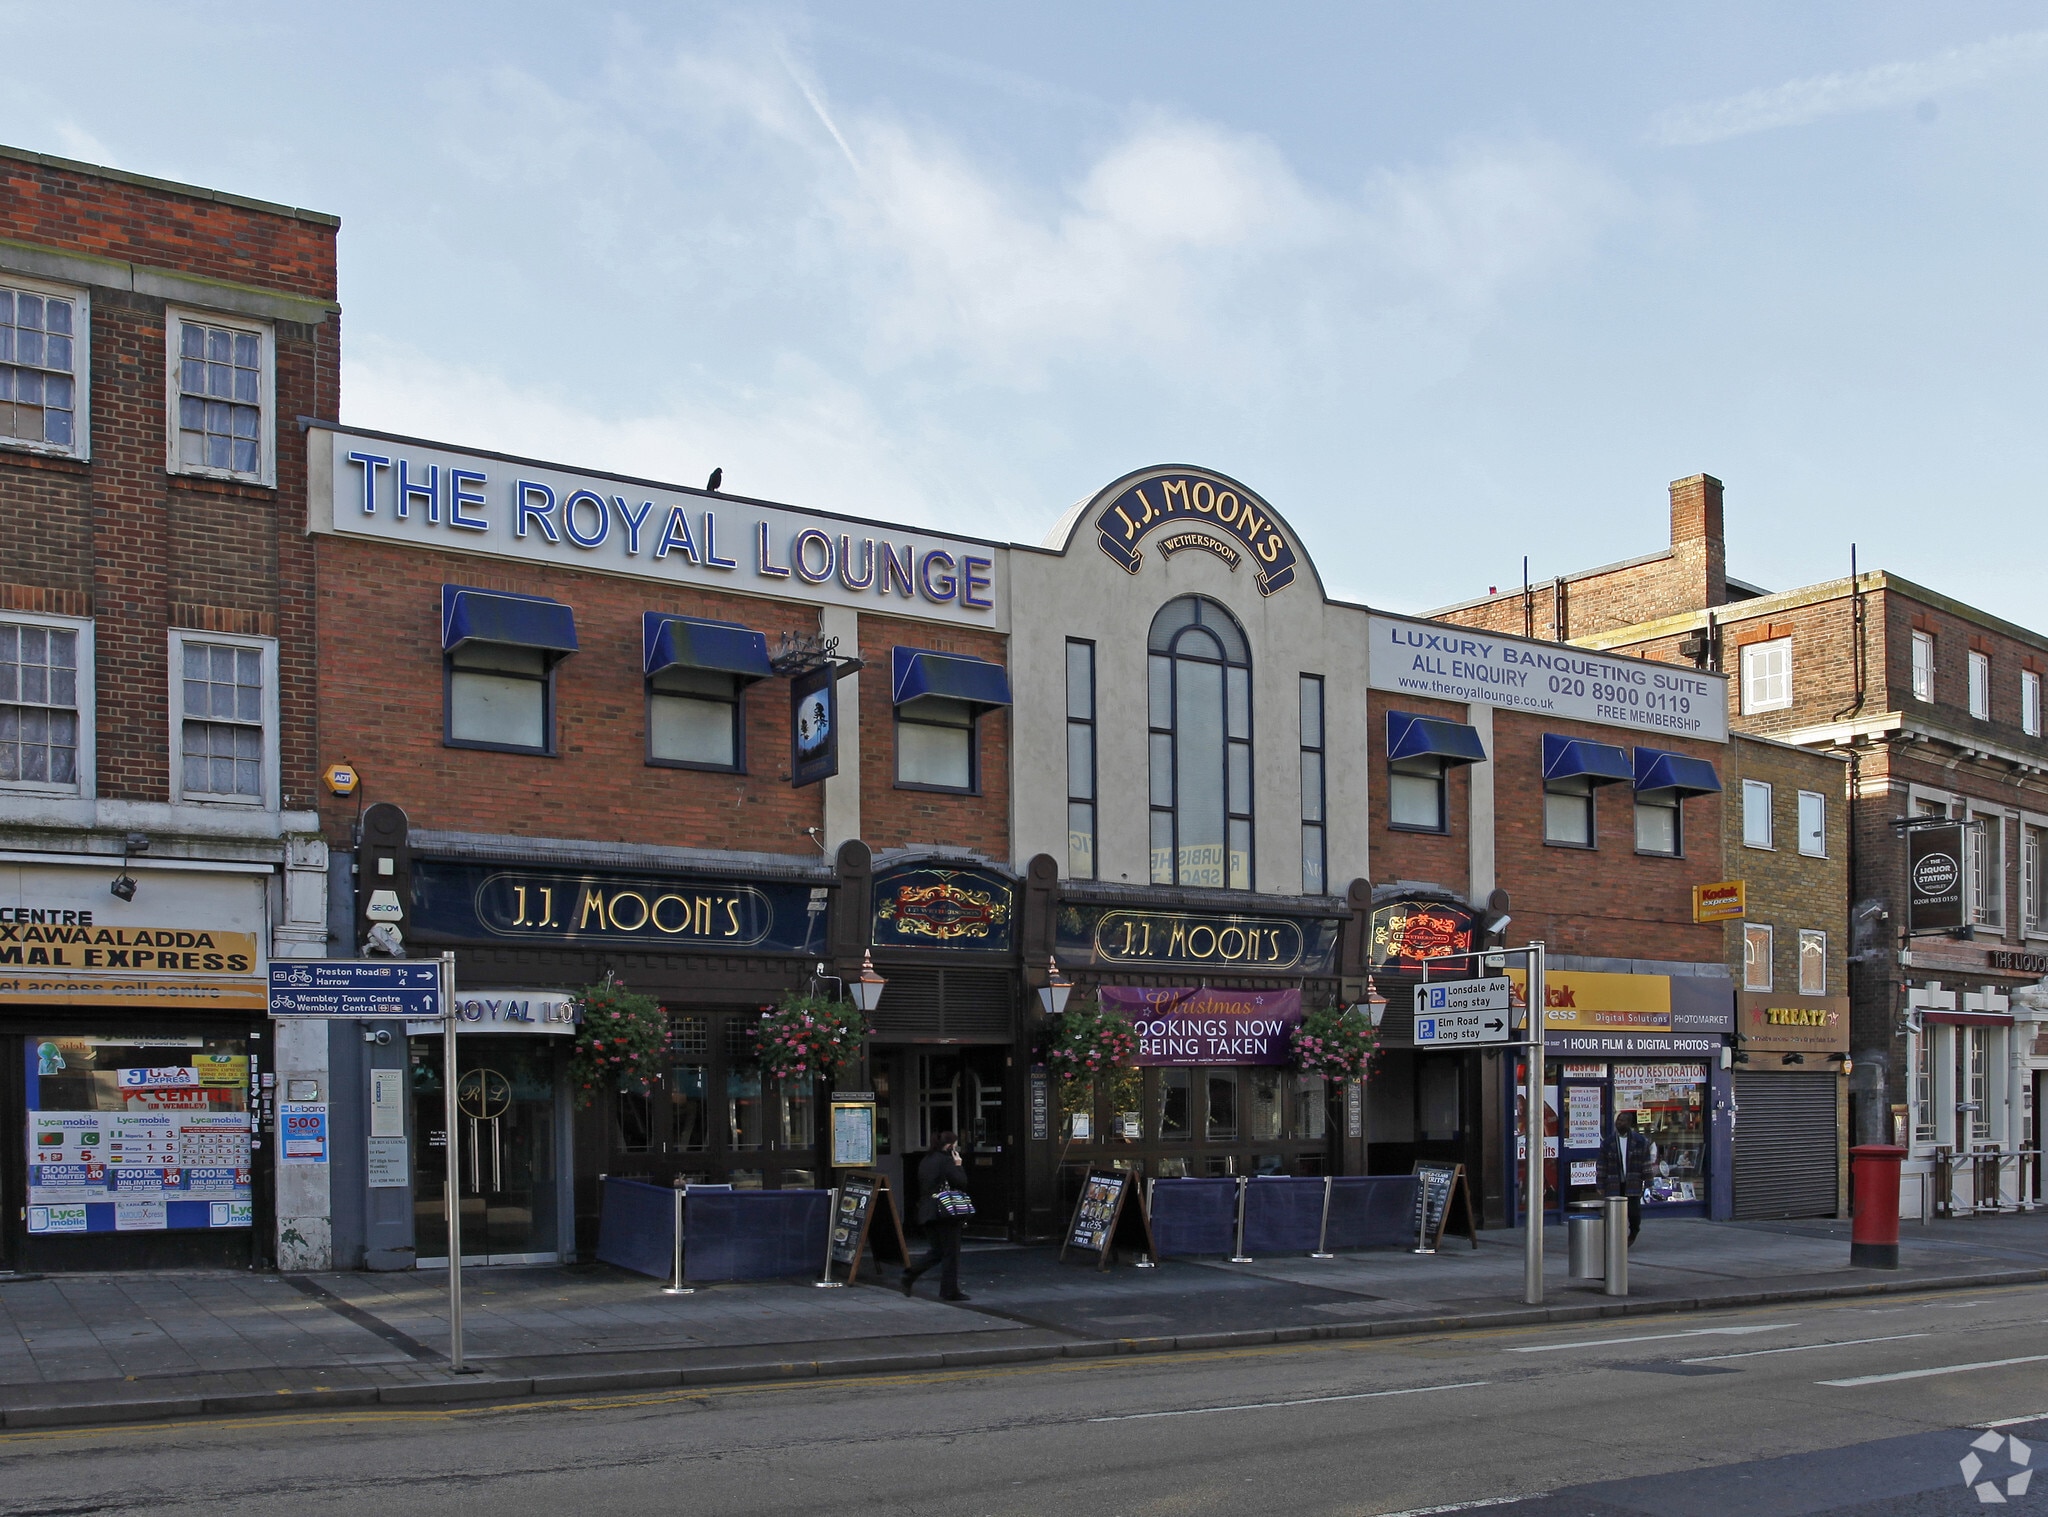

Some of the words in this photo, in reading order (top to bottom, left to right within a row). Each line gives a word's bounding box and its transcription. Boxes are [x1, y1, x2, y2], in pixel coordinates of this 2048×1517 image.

[1114, 489, 1160, 541] J.J.
[1161, 479, 1284, 562] MOON'S
[348, 450, 490, 532] THE
[515, 479, 738, 570] ROYAL
[756, 520, 994, 611] LOUNGE
[1164, 534, 1236, 562] WETHERSPOON
[1391, 628, 1493, 659] LUXURY
[1503, 648, 1646, 686] BANQUETING
[1653, 674, 1708, 697] SUITE
[1412, 654, 1447, 676] ALL
[1452, 660, 1528, 688] ENQUIRY
[1548, 675, 1585, 697] 020
[1592, 682, 1639, 706] 8900
[1646, 691, 1690, 714] 0119
[1398, 677, 1554, 709] www.theroyallounge.co.uk
[1597, 704, 1626, 721] FREE
[1630, 709, 1701, 732] MEMBERSHIP
[334, 773, 350, 782] ADT
[1920, 865, 1951, 875] LIQUOR
[1919, 873, 1953, 883] STATION
[1702, 886, 1738, 901] Kodak
[1702, 897, 1739, 906] express
[372, 904, 399, 912] SECOM
[513, 886, 559, 929] J.J.
[580, 887, 740, 936] MOON'S
[1, 907, 93, 926] CENTRE
[1121, 921, 1154, 956] J.J.
[1167, 921, 1280, 962] MOON'S
[84, 949, 248, 972] EXPRESS
[1994, 951, 2012, 969] THE
[316, 968, 352, 976] Preston
[356, 968, 379, 976] Road
[317, 978, 350, 986] Harrow
[399, 978, 406, 986] 4
[112, 983, 148, 997] call
[1448, 985, 1486, 995] Lonsdale
[1489, 982, 1505, 991] Ave
[297, 995, 339, 1004] Wembley
[342, 995, 366, 1003] Town
[369, 995, 401, 1003] Centre
[1145, 990, 1257, 1016] Christmas
[1448, 999, 1468, 1009] Long
[1471, 997, 1490, 1007] stay
[297, 1004, 339, 1013] Wembley
[342, 1004, 377, 1012] Central
[1438, 1018, 1454, 1027] Elm
[1457, 1016, 1479, 1026] Road
[1595, 1013, 1625, 1024] Digital
[1628, 1013, 1667, 1023] Solutions
[1674, 1014, 1729, 1024] PHOTOMARKET
[1767, 1008, 1827, 1027] TREATZ
[1133, 1020, 1227, 1037] OOKINGS
[1235, 1020, 1283, 1037] NOW
[1438, 1030, 1458, 1040] Long
[1461, 1030, 1480, 1039] stay
[1139, 1039, 1199, 1056] BEING
[1207, 1038, 1268, 1055] TAKEN
[1562, 1039, 1568, 1049] 1
[1571, 1039, 1598, 1049] HOUR
[1602, 1039, 1623, 1050] FILM
[1627, 1039, 1634, 1050] &
[1637, 1039, 1671, 1050] DIGITAL
[1673, 1039, 1709, 1050] PHOTOS
[1614, 1067, 1644, 1078] PHOTO
[1647, 1065, 1706, 1077] RESTORATION
[122, 1089, 147, 1102] PC
[154, 1088, 232, 1102] CENTRE
[461, 1086, 480, 1101] R
[162, 1102, 207, 1110] WEMBLEY)
[290, 1104, 326, 1113] Lebara
[38, 1119, 98, 1128] Lycamobile
[117, 1116, 170, 1125] Lycamobile
[190, 1116, 242, 1125] Lycamobile
[288, 1117, 320, 1128] 500
[166, 1130, 174, 1138] 3
[147, 1143, 153, 1151] 1
[166, 1143, 174, 1151] 5
[80, 1150, 92, 1161] 5
[147, 1155, 154, 1163] 7
[161, 1155, 174, 1163] 12
[42, 1166, 67, 1174] 500
[87, 1170, 103, 1179] £10
[117, 1169, 143, 1179] 500
[190, 1169, 216, 1178] 500
[164, 1174, 180, 1183] £10
[50, 1208, 85, 1220] Lyca
[50, 1218, 85, 1226] mobile
